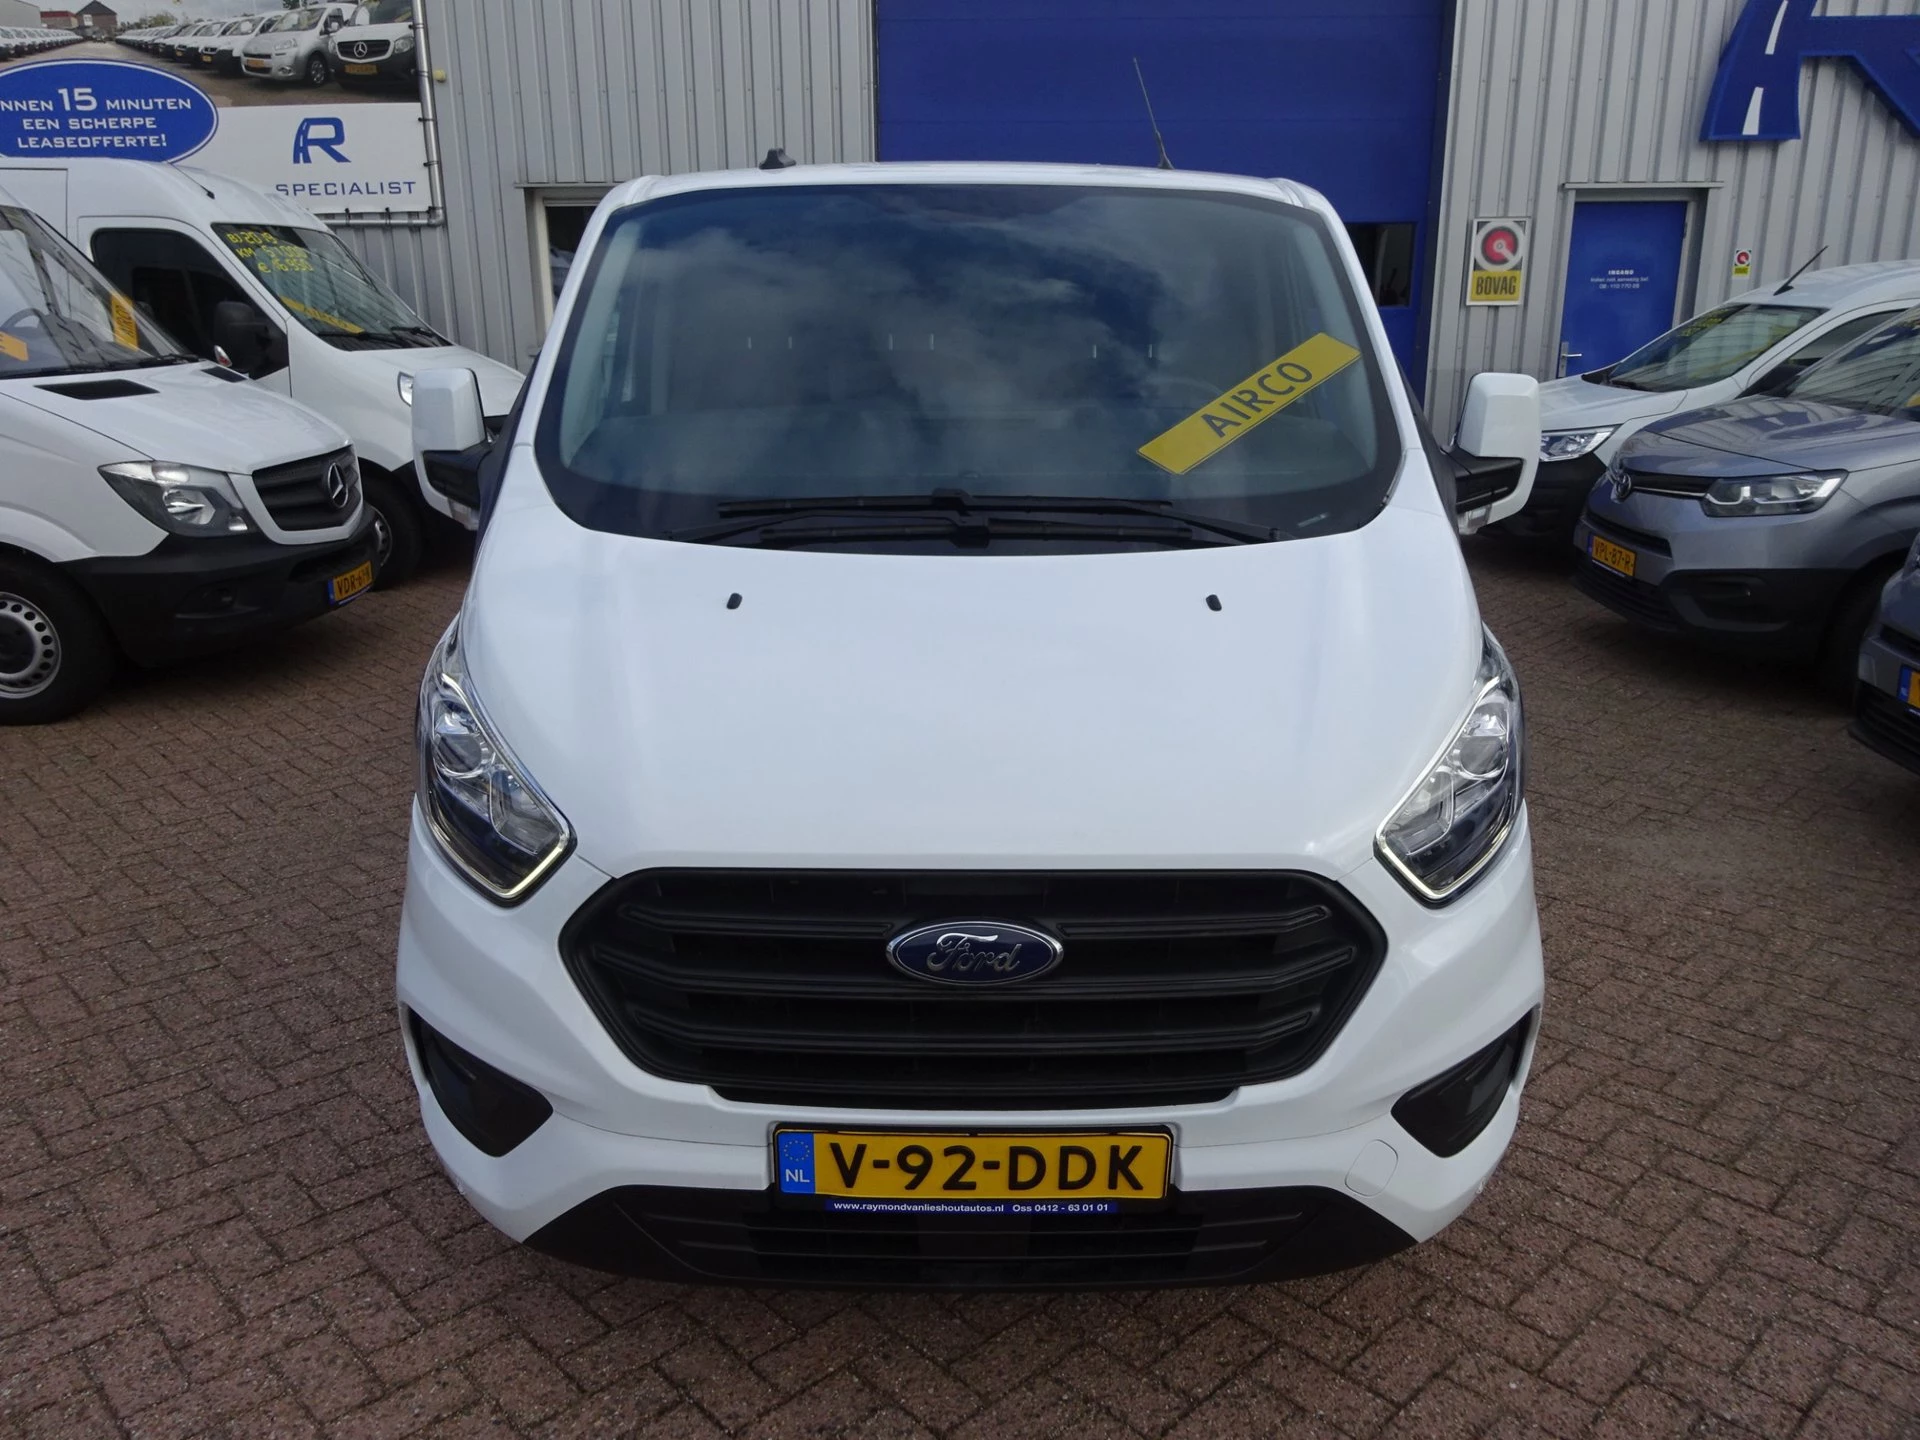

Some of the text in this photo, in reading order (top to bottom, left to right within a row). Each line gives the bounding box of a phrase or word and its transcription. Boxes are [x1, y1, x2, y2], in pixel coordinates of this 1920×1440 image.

[58, 88, 98, 112] 15
[106, 98, 191, 110] MINUTEN
[23, 117, 158, 130] EEN SCHERPE
[17, 134, 168, 149] LEASEOFFERTE!
[275, 181, 416, 197] SPECIALIST
[1475, 275, 1517, 296] BOVAG
[1200, 362, 1313, 438] AIRCO
[926, 932, 1022, 972] Ford
[785, 1141, 1144, 1192] NL V-92-DDK
[833, 1201, 1004, 1213] www.raymondvanlieshoutautos.nl
[1012, 1203, 1033, 1212] Oss
[1034, 1203, 1059, 1212] 0412
[1067, 1203, 1080, 1212] 63
[1081, 1203, 1094, 1212] 01
[1096, 1203, 1109, 1212] 01
